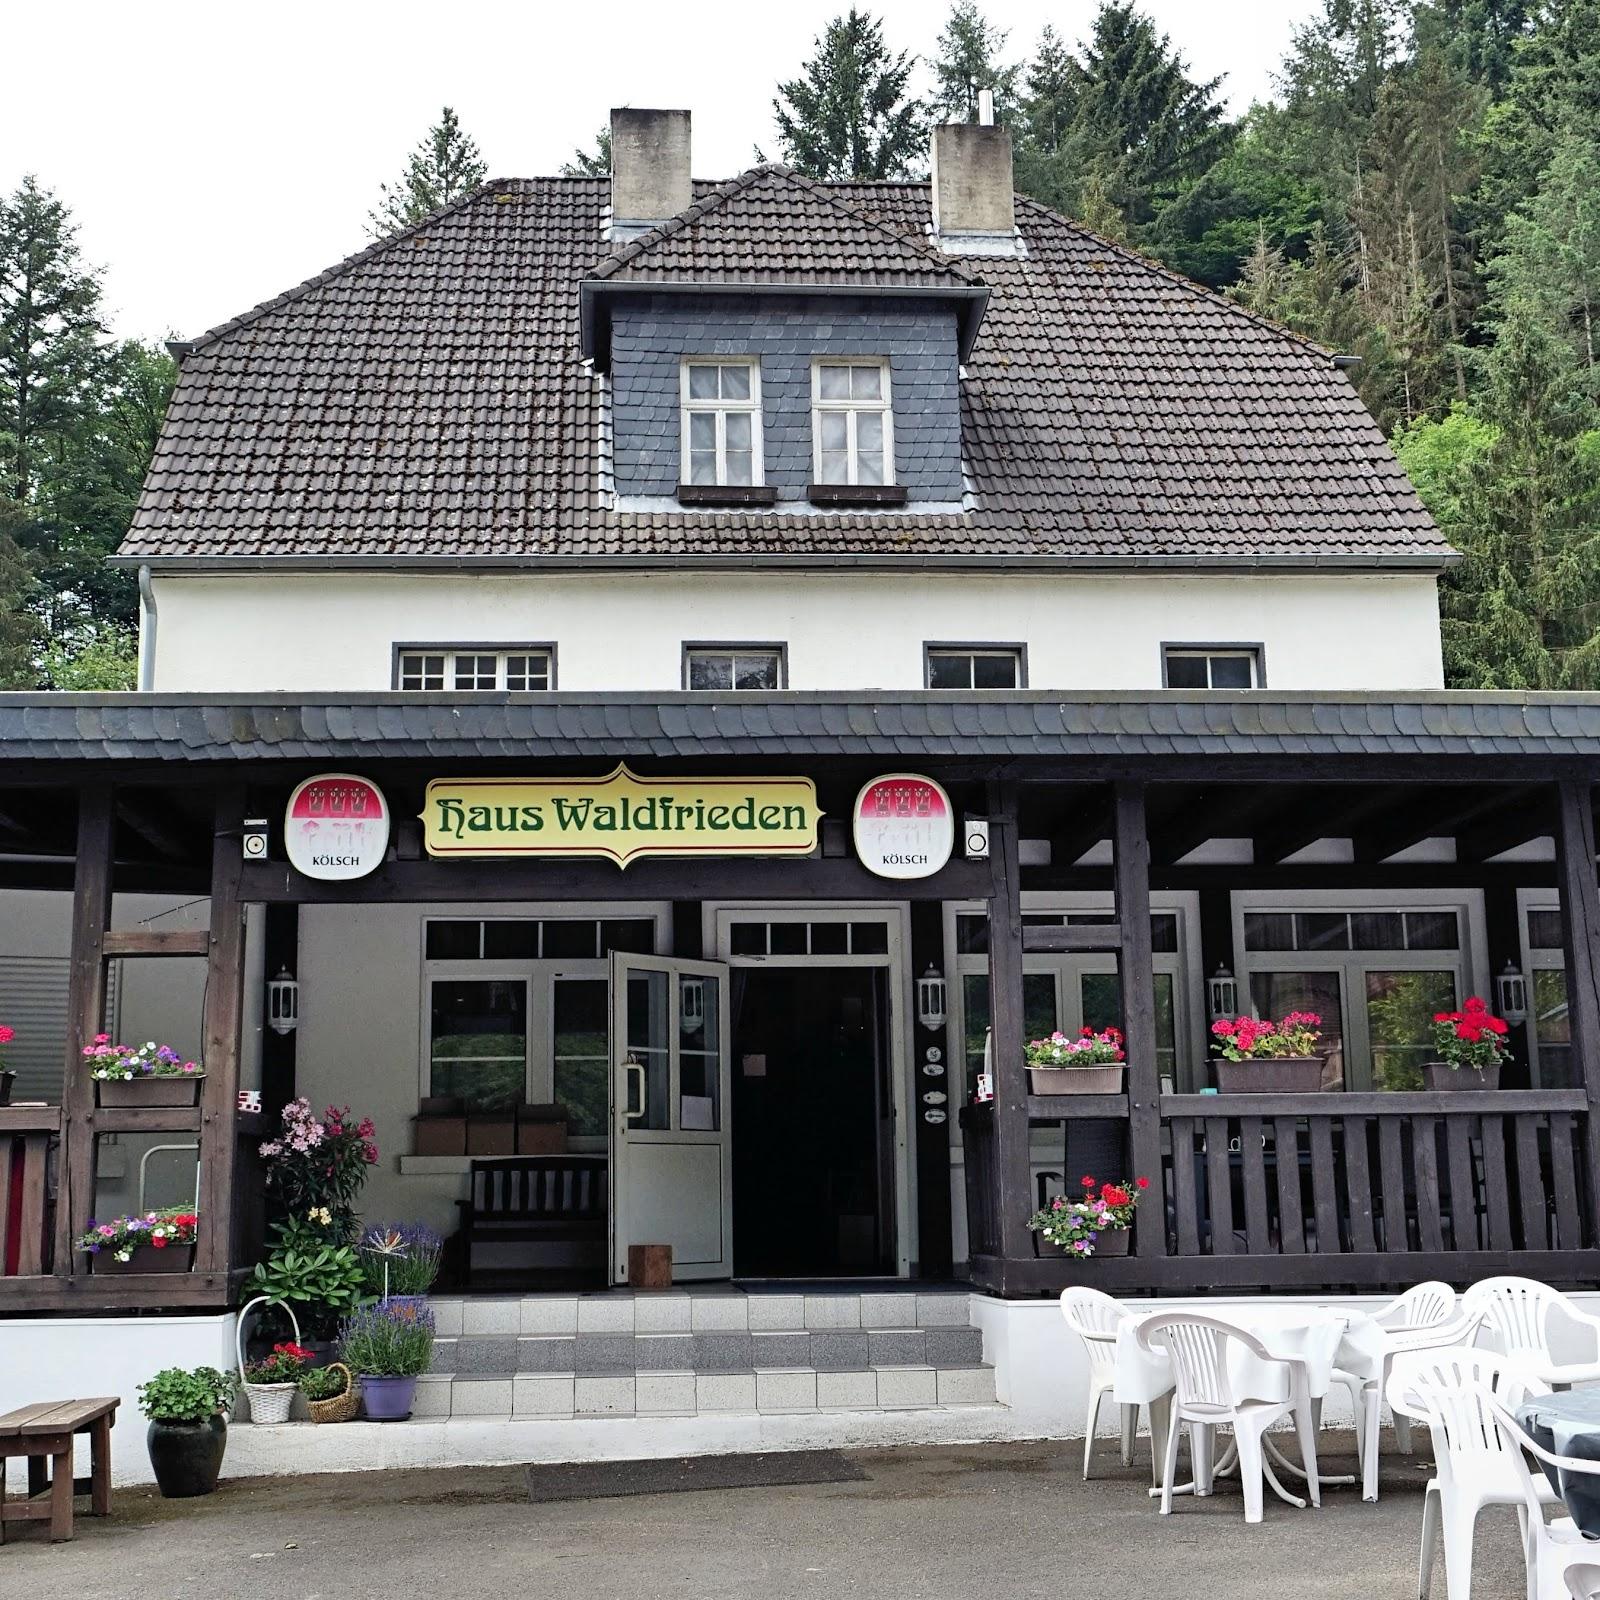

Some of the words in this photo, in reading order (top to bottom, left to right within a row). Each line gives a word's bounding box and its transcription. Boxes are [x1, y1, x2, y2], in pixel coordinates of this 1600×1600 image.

[551, 797, 807, 831] Waldfrieden
[312, 854, 360, 866] KÖLSCH
[882, 853, 928, 865] KÖLSCH
